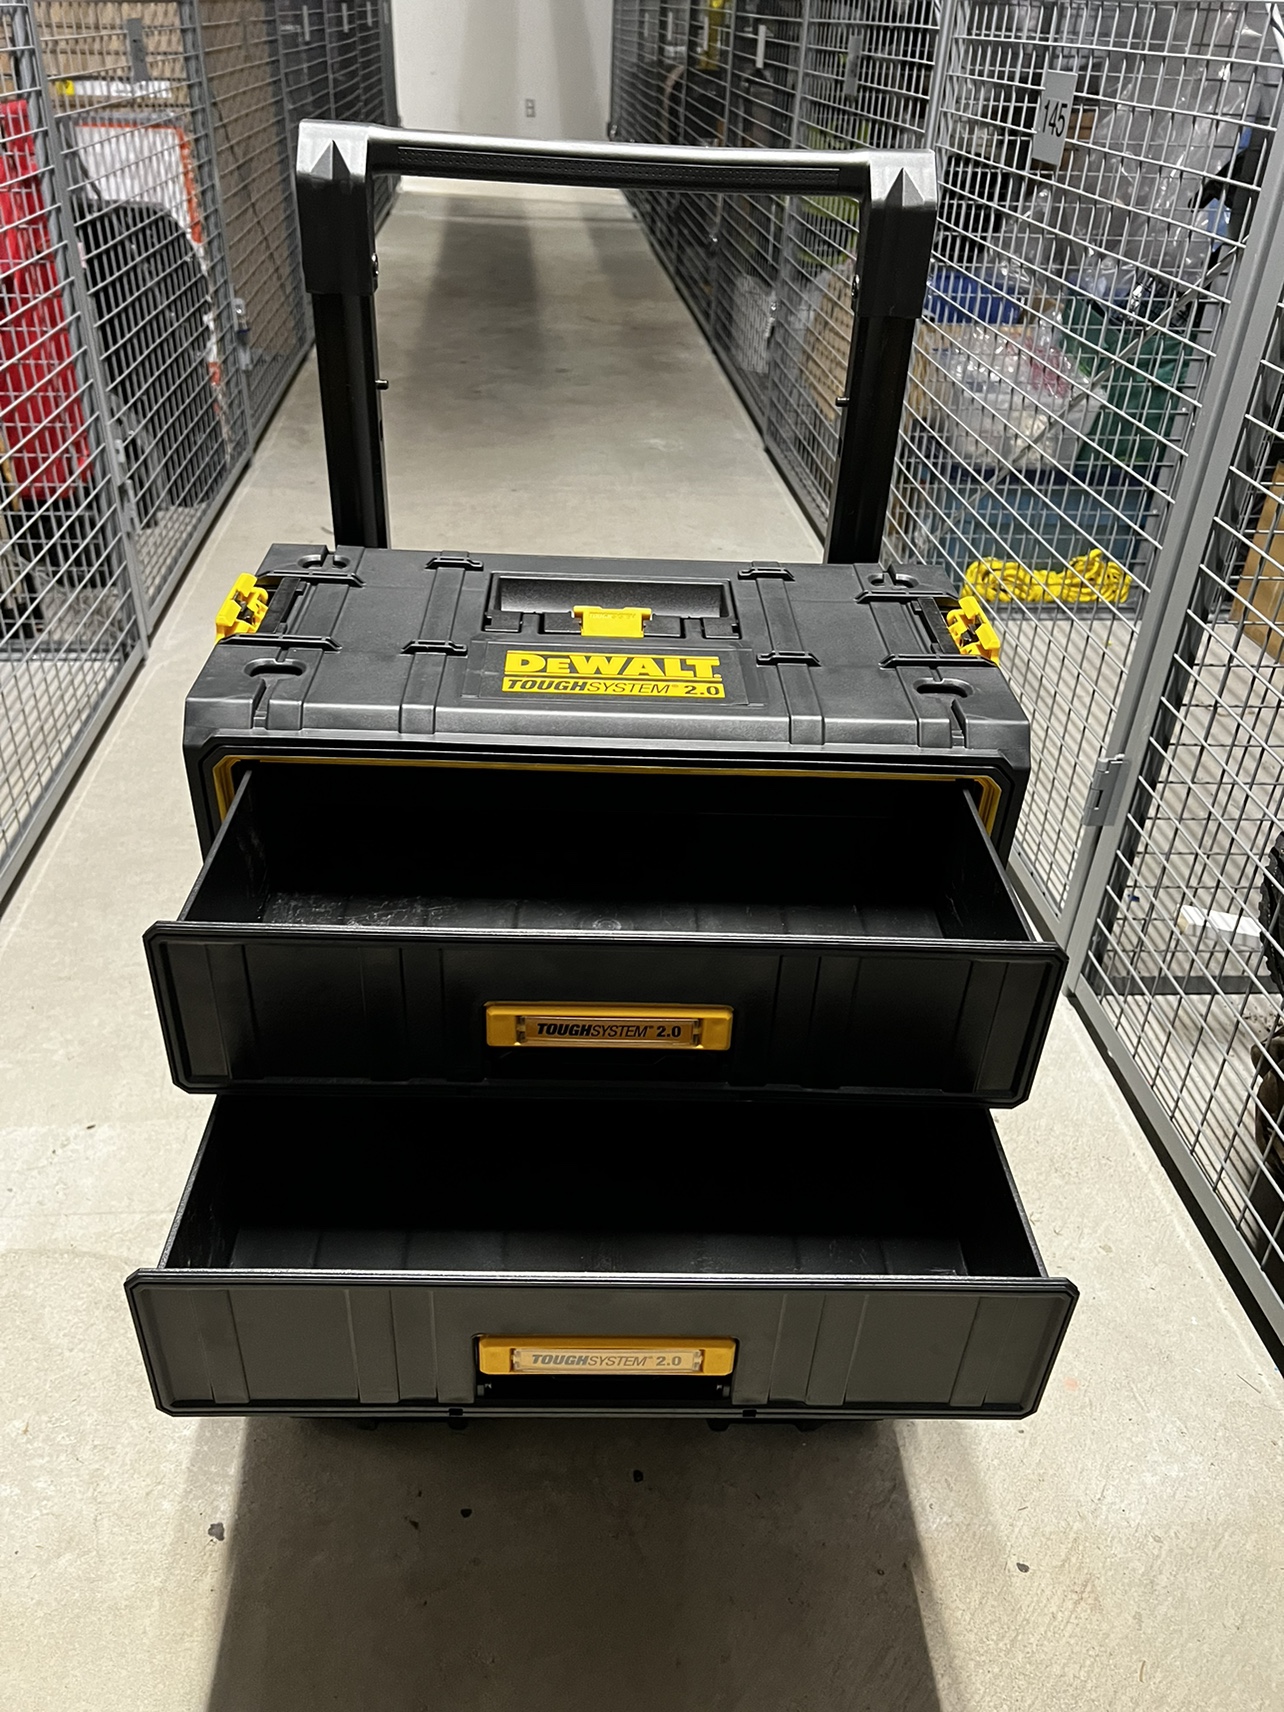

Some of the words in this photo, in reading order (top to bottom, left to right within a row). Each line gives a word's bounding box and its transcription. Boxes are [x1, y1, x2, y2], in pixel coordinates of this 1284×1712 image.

[1042, 99, 1068, 137] 145
[684, 685, 720, 696] 2.0
[656, 1026, 682, 1038] 2.0
[655, 1356, 682, 1367] 2.0
